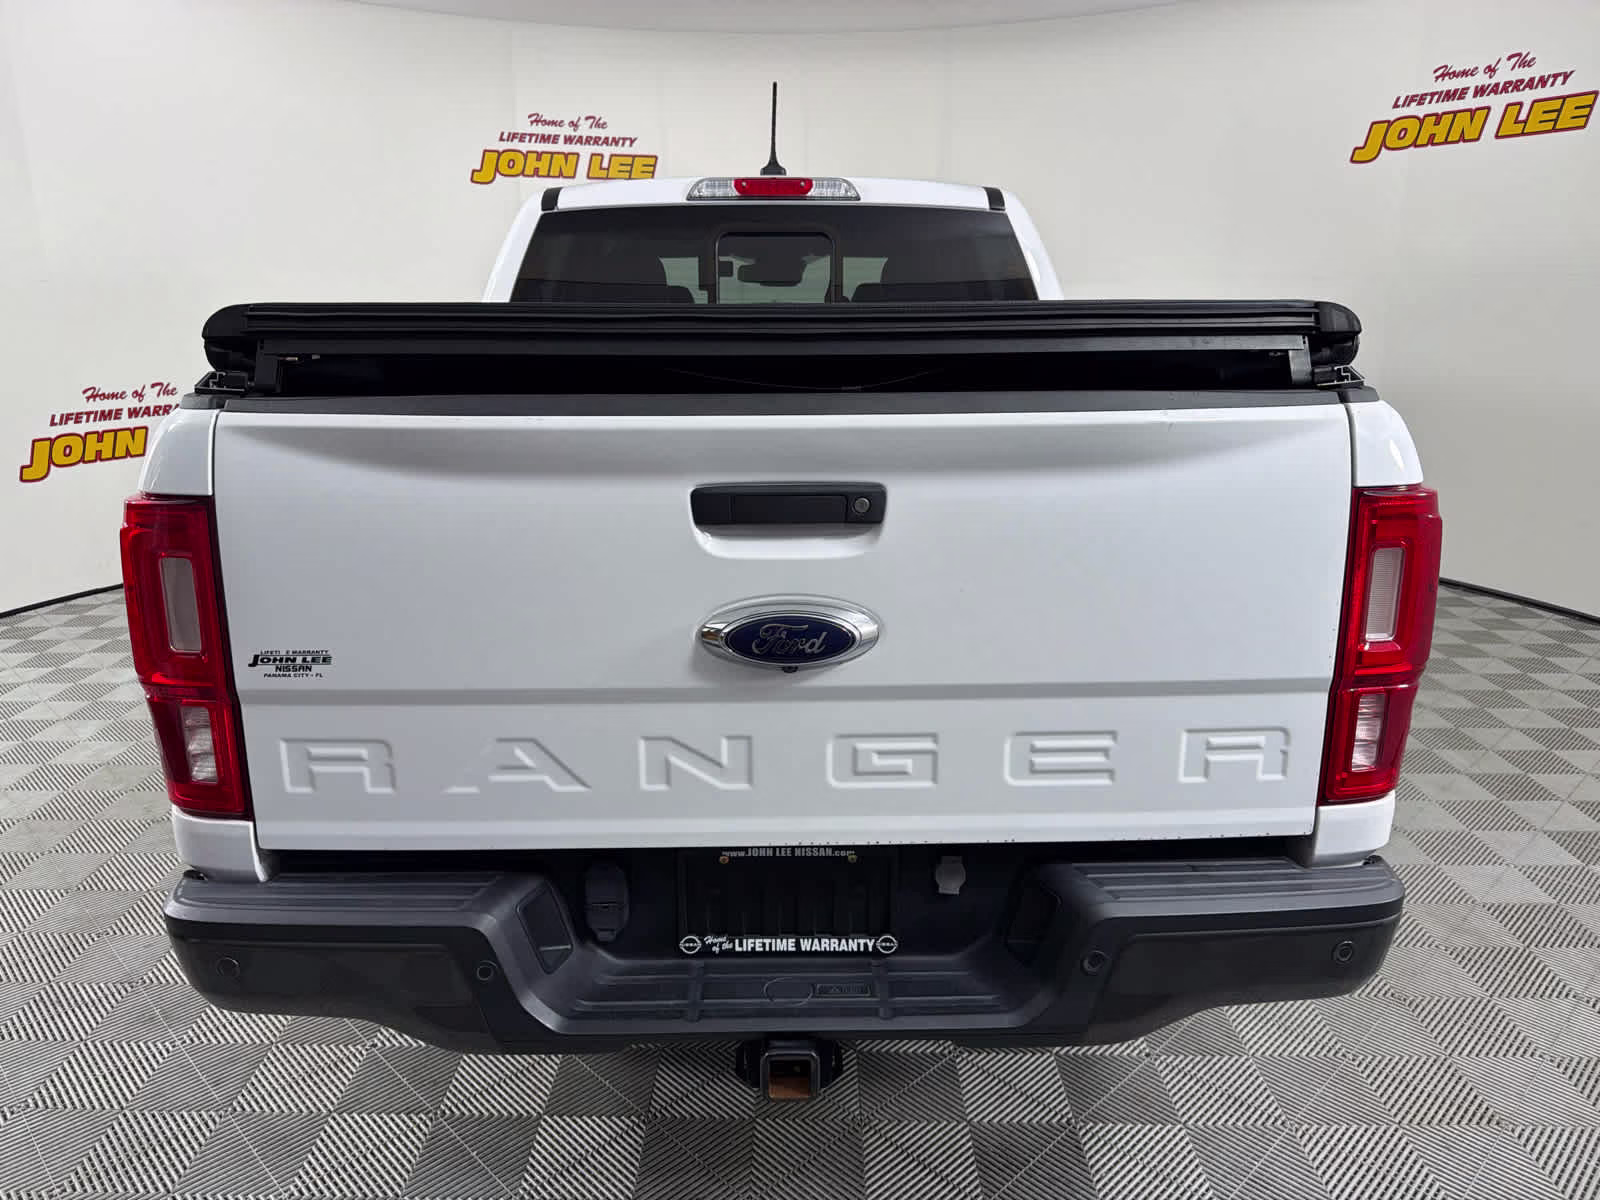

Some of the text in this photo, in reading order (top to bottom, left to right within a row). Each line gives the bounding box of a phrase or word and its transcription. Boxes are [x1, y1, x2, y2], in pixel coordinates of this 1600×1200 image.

[1433, 51, 1537, 83] Home of The
[1392, 70, 1576, 109] LIFETIME WARRANTY
[528, 113, 608, 132] Home of The
[1350, 90, 1599, 164] JOHN LEE
[499, 131, 638, 148] LIFETIME WARRANTY
[470, 149, 658, 185] JOHN LEE
[82, 382, 178, 403] Home of The
[50, 408, 123, 427] LIFETIME
[20, 426, 148, 483] JOHN
[752, 623, 828, 655] Ford
[248, 654, 332, 667] JOHN LEE
[279, 726, 1291, 793] RANGER
[775, 847, 792, 857] LEE
[735, 939, 875, 952] LIFETIME WARRANTY
